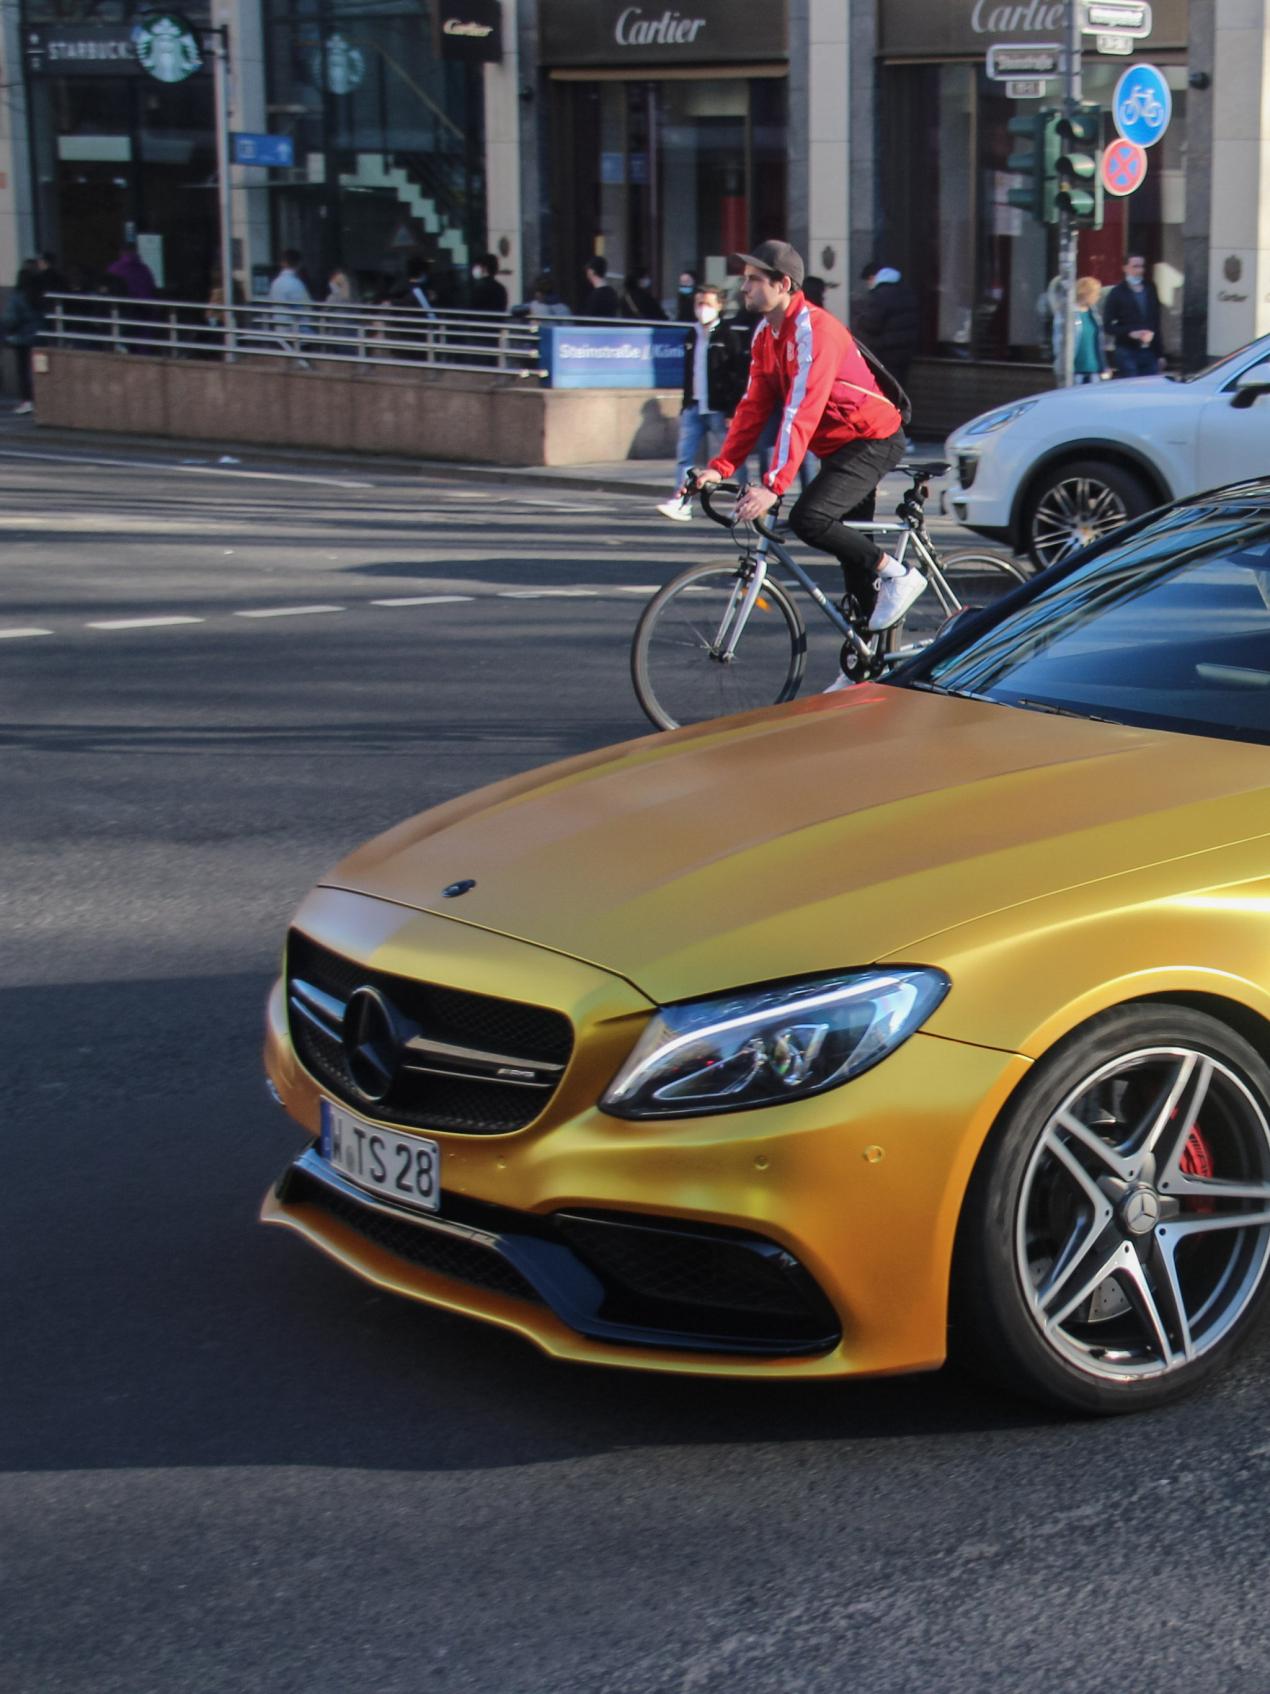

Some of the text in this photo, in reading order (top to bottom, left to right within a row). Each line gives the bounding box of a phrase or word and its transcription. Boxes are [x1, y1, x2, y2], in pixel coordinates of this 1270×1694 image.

[614, 7, 706, 46] Cartier
[971, 0, 1068, 33] Cartie
[47, 42, 135, 60] STARBUCK
[559, 343, 641, 359] Steinstraße
